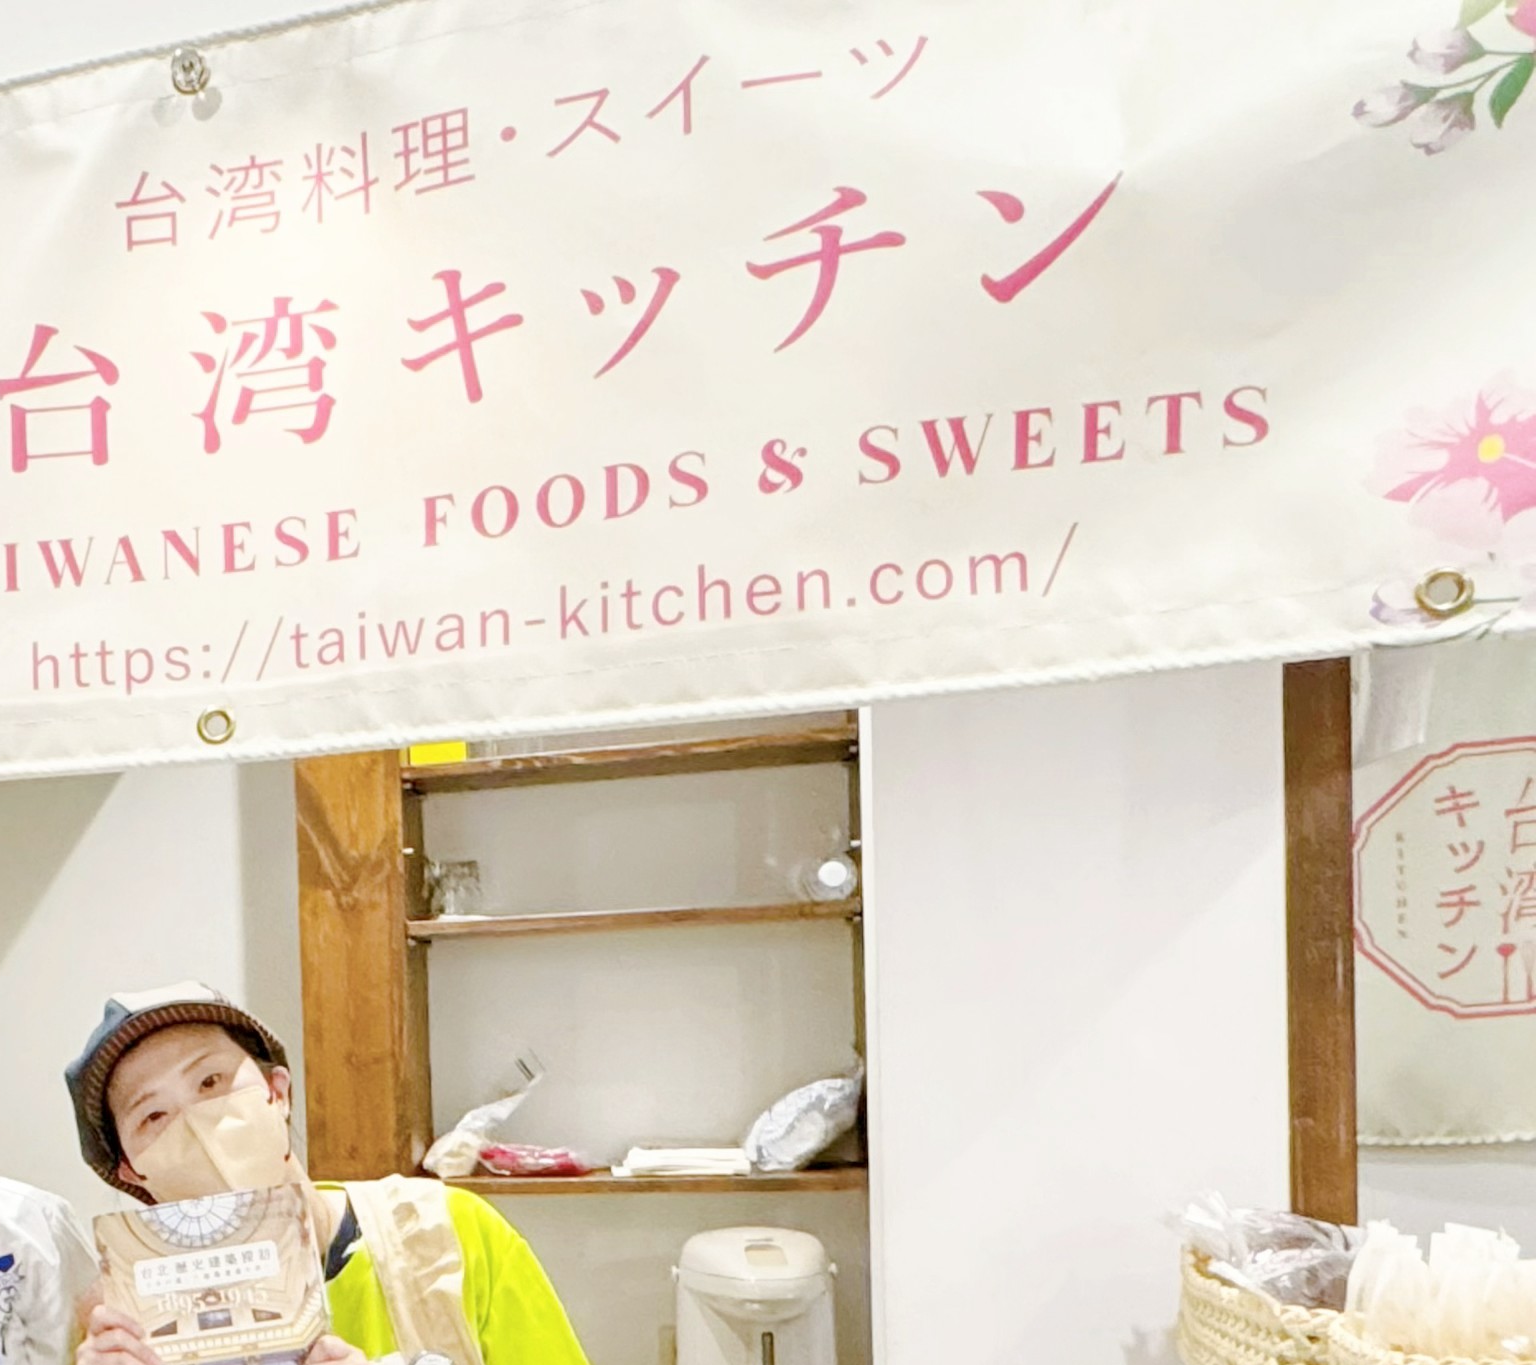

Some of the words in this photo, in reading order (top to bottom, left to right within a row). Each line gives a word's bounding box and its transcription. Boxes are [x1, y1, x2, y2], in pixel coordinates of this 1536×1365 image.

[115, 35, 929, 252] 台湾料理・スイーツ
[421, 450, 711, 548] FOODS
[757, 437, 809, 495] &
[857, 384, 1272, 488] SWEETS
[31, 521, 1080, 694] https://taiwan-kitchen.com/
[1434, 784, 1486, 980] キッチン
